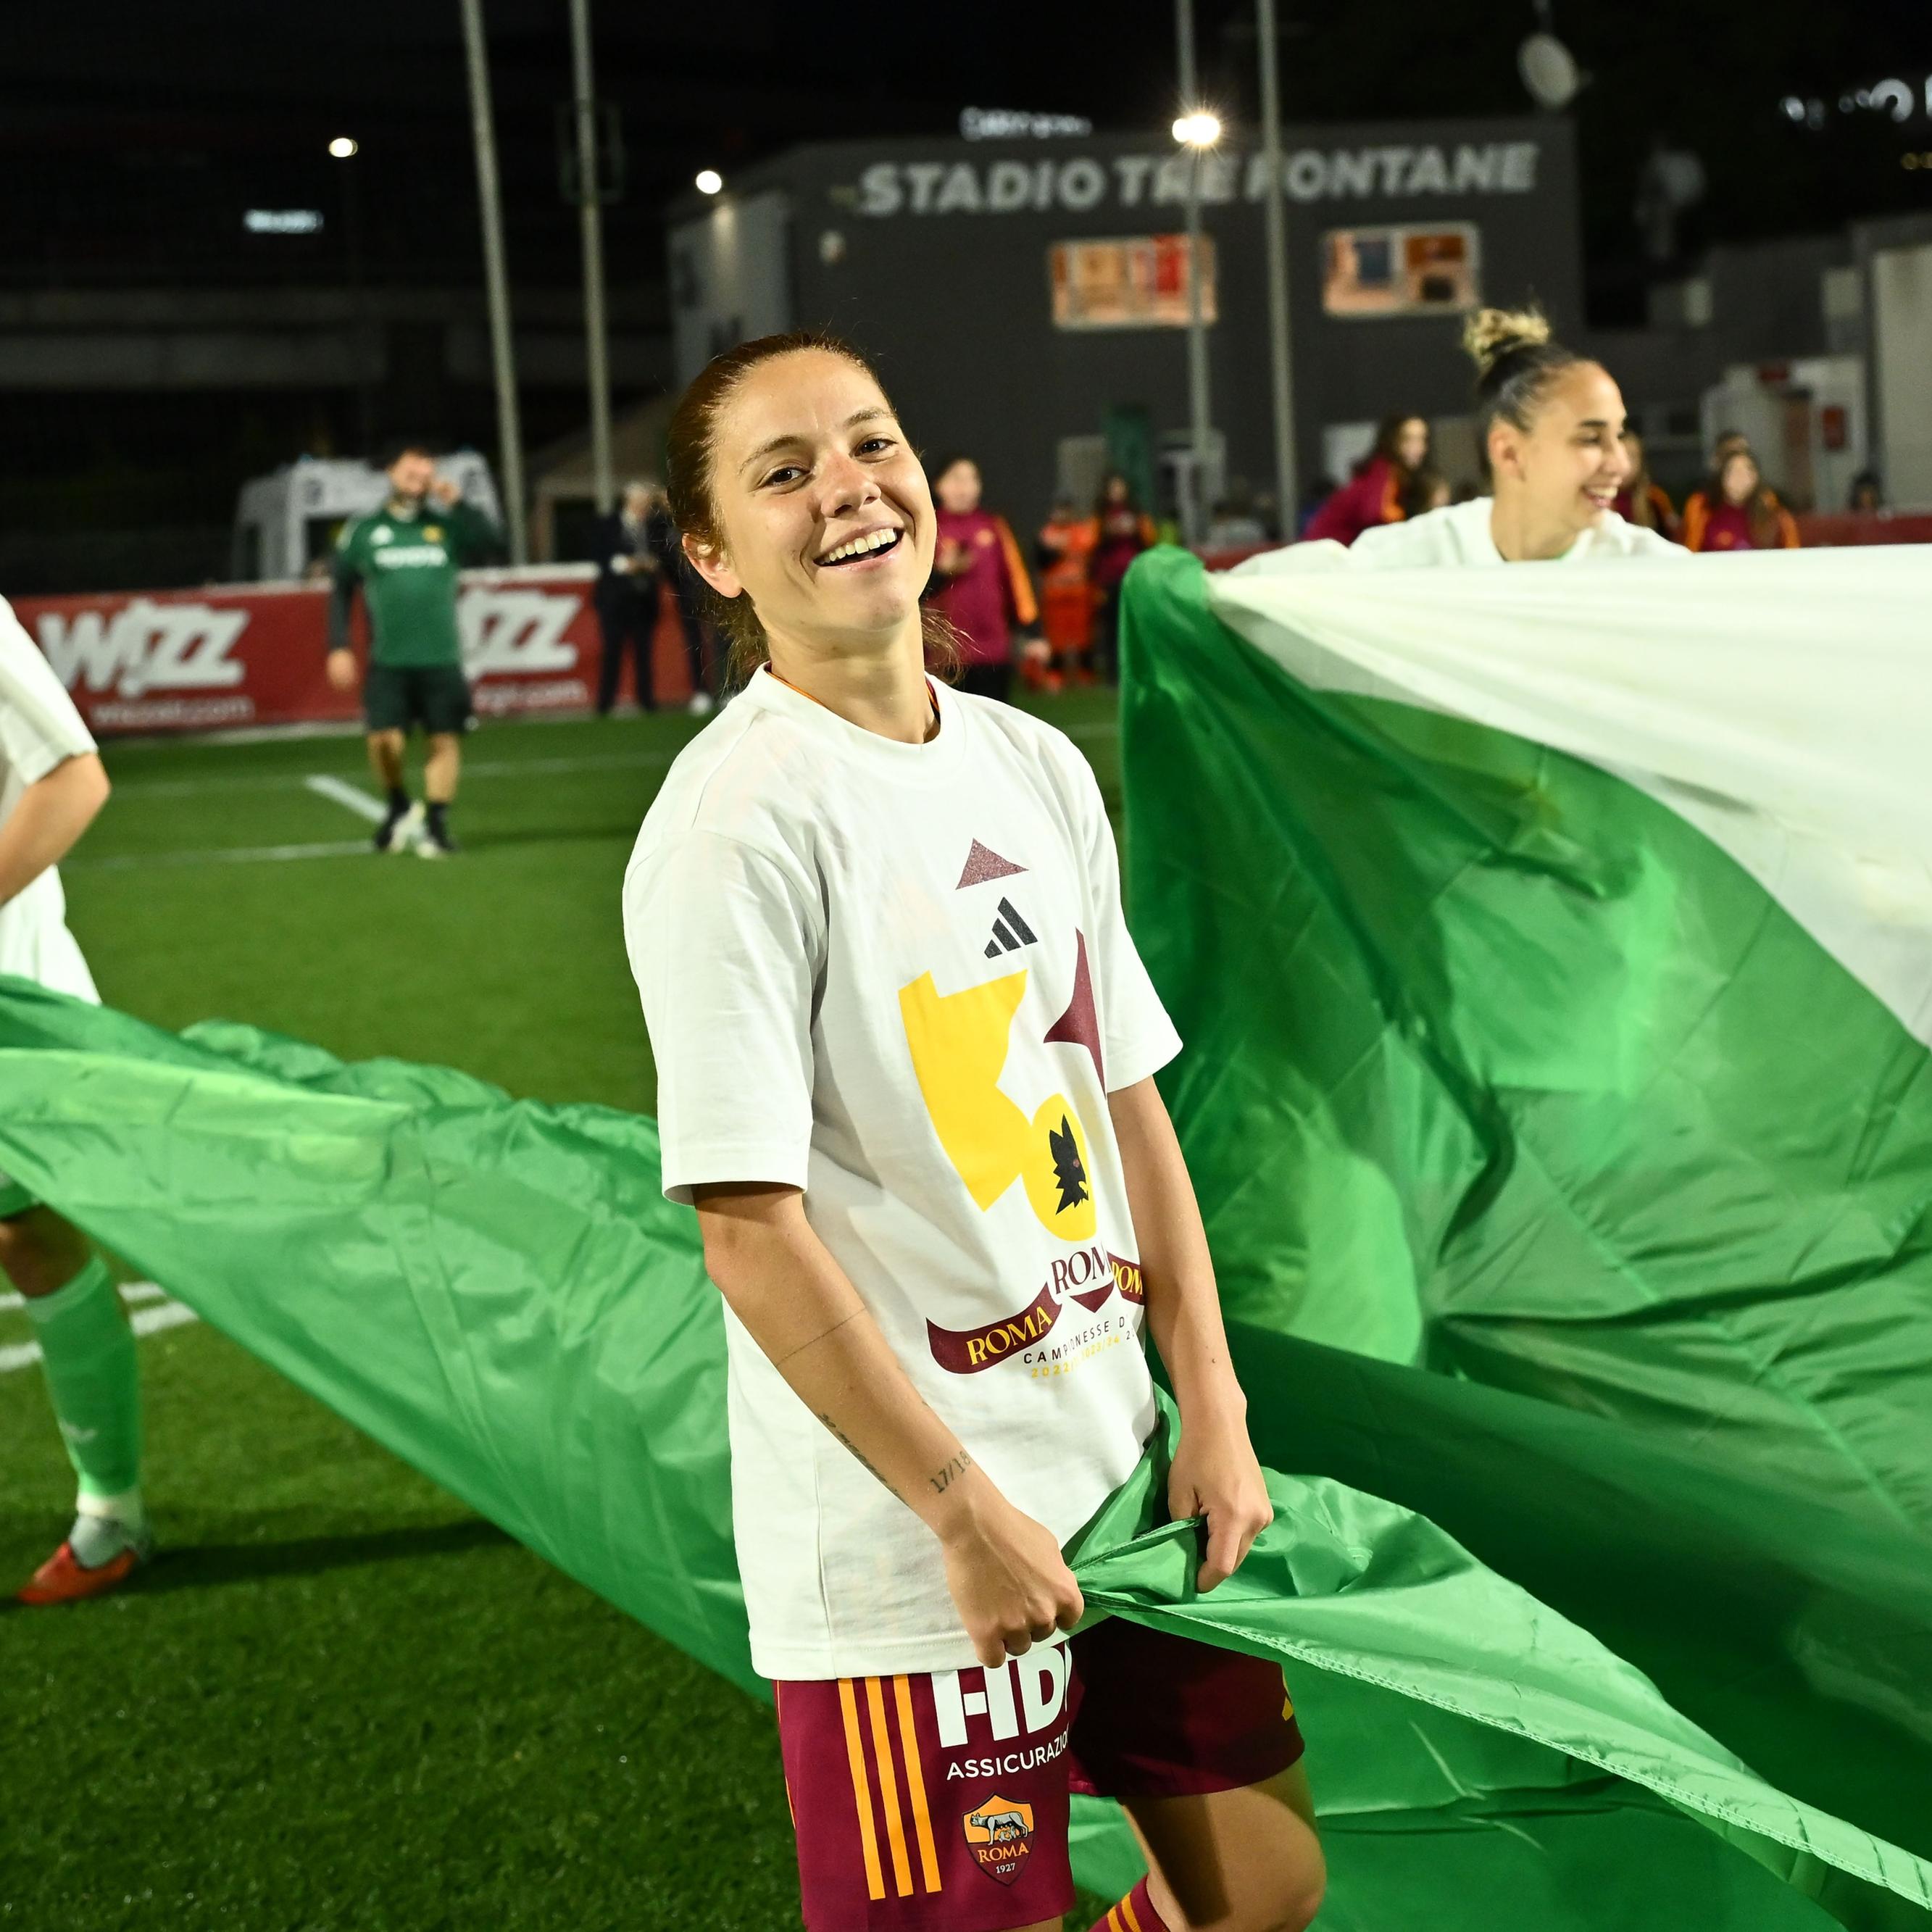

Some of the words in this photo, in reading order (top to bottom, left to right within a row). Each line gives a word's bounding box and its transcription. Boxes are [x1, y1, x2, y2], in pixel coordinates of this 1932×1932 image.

[859, 157, 1106, 217] STADIO
[1113, 151, 1236, 207] TRE
[966, 1305, 1053, 1366] ROMA
[1023, 1320, 1110, 1364] CAMPIONESSE
[930, 1450, 972, 1494] 17/18
[946, 1720, 1070, 1781] ASSICURAZIO
[978, 1842, 1029, 1863] ROMA
[996, 1862, 1015, 1874] 1927
